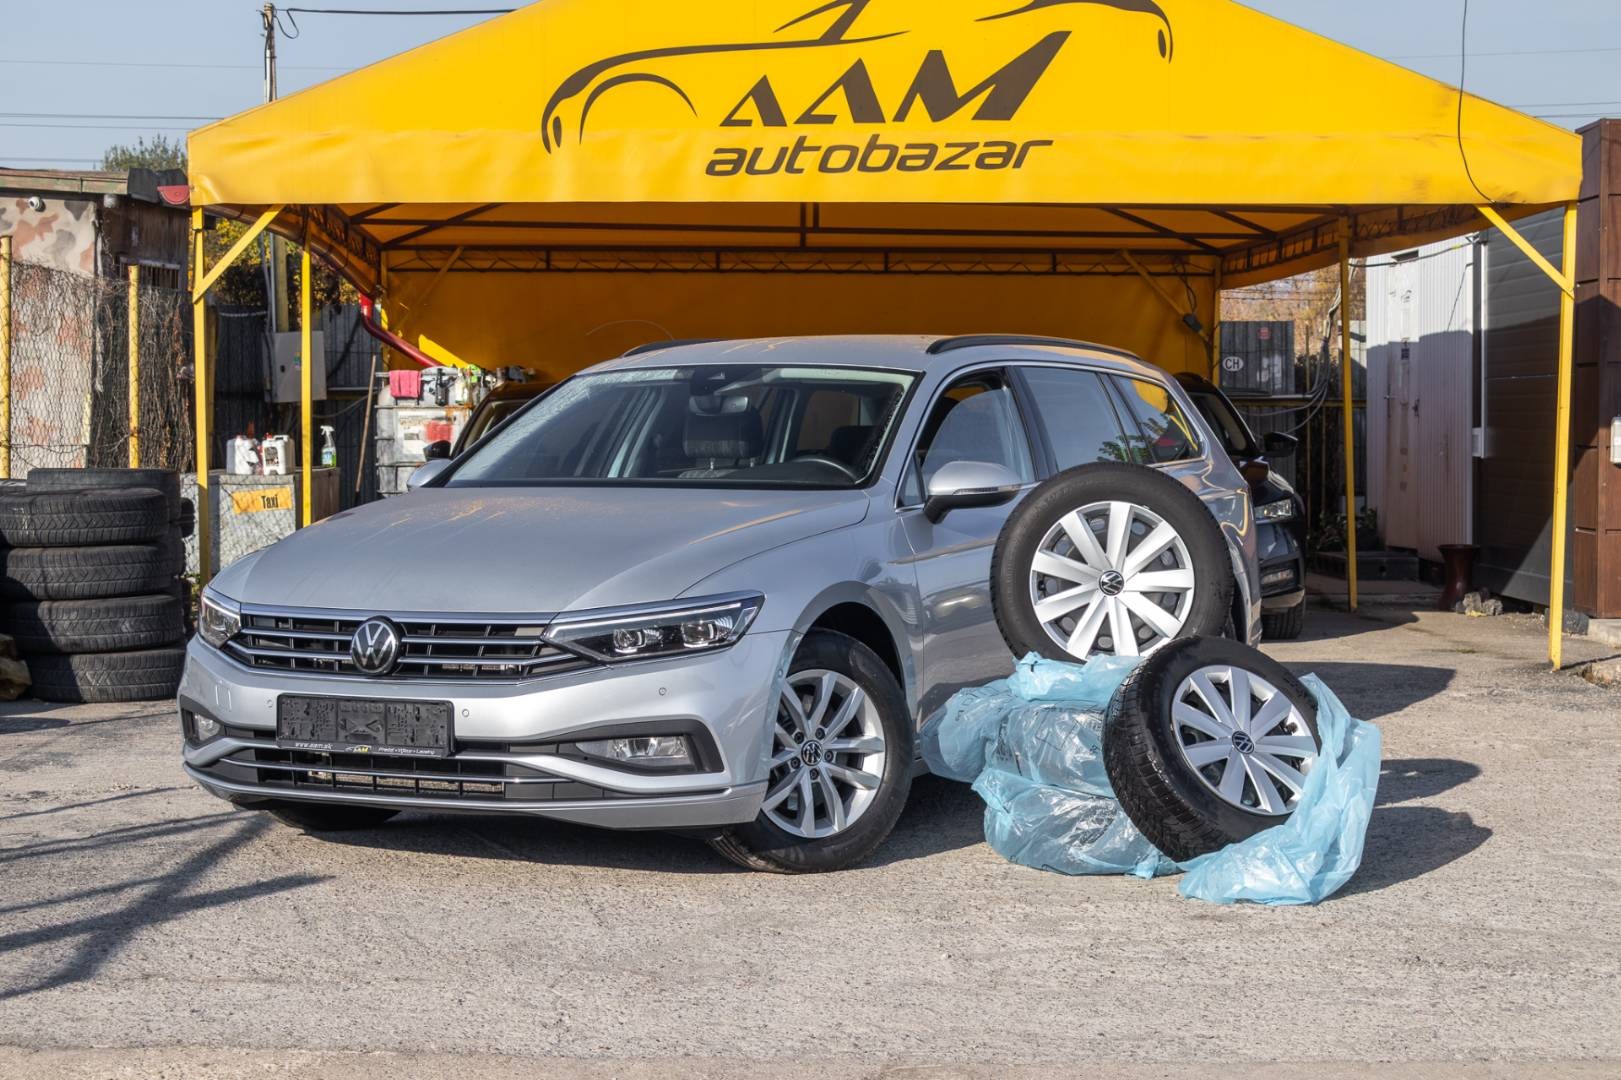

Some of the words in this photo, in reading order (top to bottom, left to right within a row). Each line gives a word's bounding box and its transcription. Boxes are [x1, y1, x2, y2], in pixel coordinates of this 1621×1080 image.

[719, 31, 1072, 127] AAM
[706, 134, 1053, 177] autobazar
[1225, 358, 1241, 370] CH
[261, 495, 279, 509] Taxi
[352, 621, 396, 671] VW
